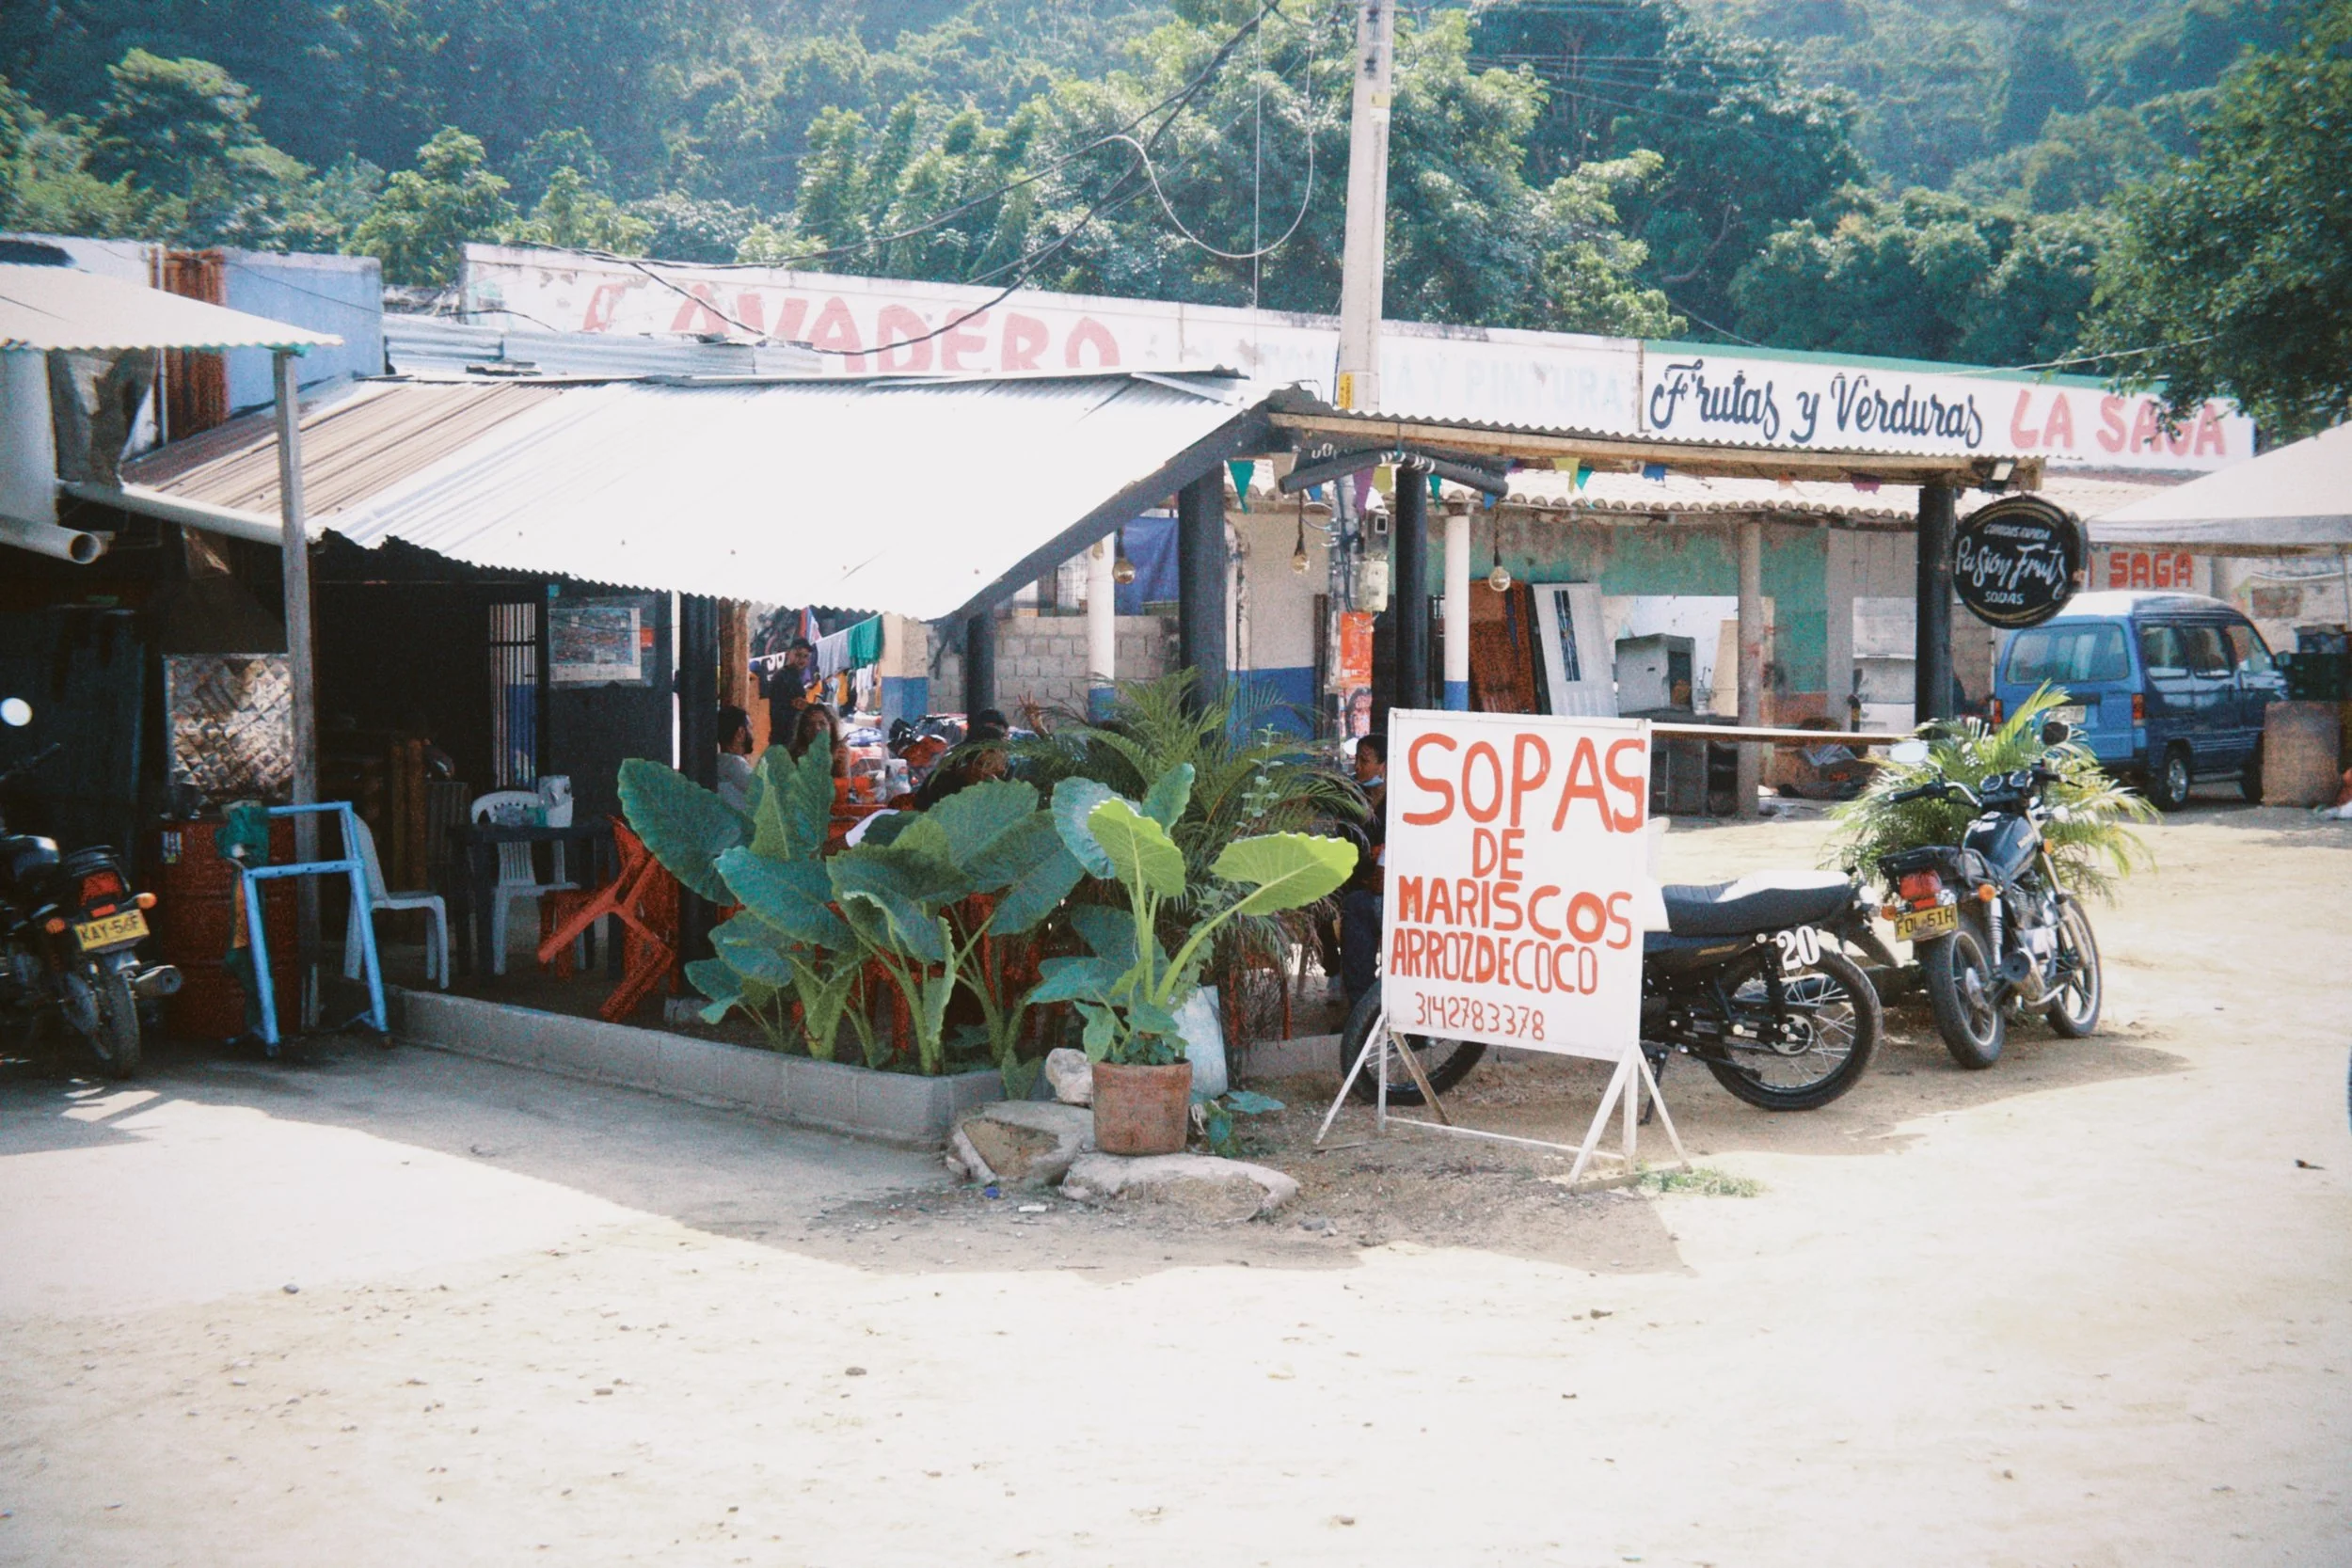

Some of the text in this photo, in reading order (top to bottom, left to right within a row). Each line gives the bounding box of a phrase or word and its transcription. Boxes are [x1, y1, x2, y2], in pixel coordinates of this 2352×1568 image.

[1463, 357, 1623, 414] PINTURA
[1649, 358, 1984, 449] Frutas y Verduras
[2010, 388, 2074, 450] LA
[2109, 550, 2193, 588] SAGA
[1984, 591, 2025, 605] SODAS
[1402, 733, 1645, 832] SOPAS
[1472, 828, 1525, 880] DE
[1398, 875, 1632, 950] MARISCOS
[1776, 926, 1820, 970] 20
[1415, 992, 1545, 1040] 3142783378
